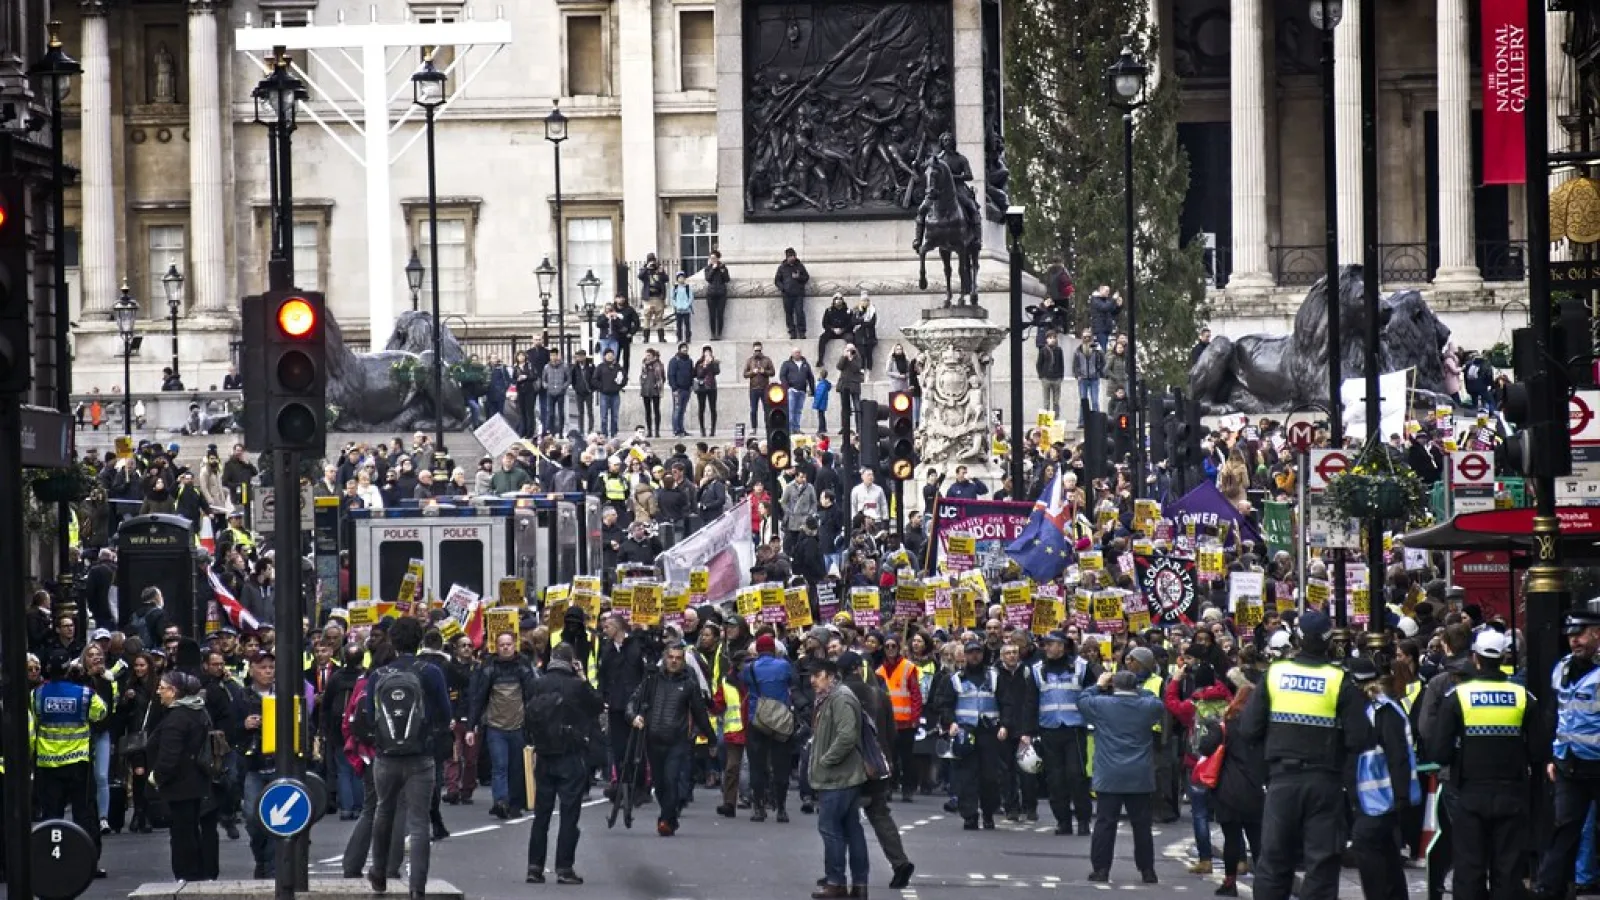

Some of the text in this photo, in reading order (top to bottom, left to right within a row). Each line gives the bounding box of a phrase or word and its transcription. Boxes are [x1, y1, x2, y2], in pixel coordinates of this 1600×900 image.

[1495, 23, 1509, 112] NATIONAL
[1509, 24, 1526, 113] GALLERY
[1293, 426, 1312, 444] M
[383, 529, 420, 539] POLICE
[443, 527, 479, 538] POLICE
[1280, 674, 1326, 693] POLICE
[1471, 692, 1516, 705] POLICE
[51, 829, 62, 843] B
[51, 845, 62, 860] 4
